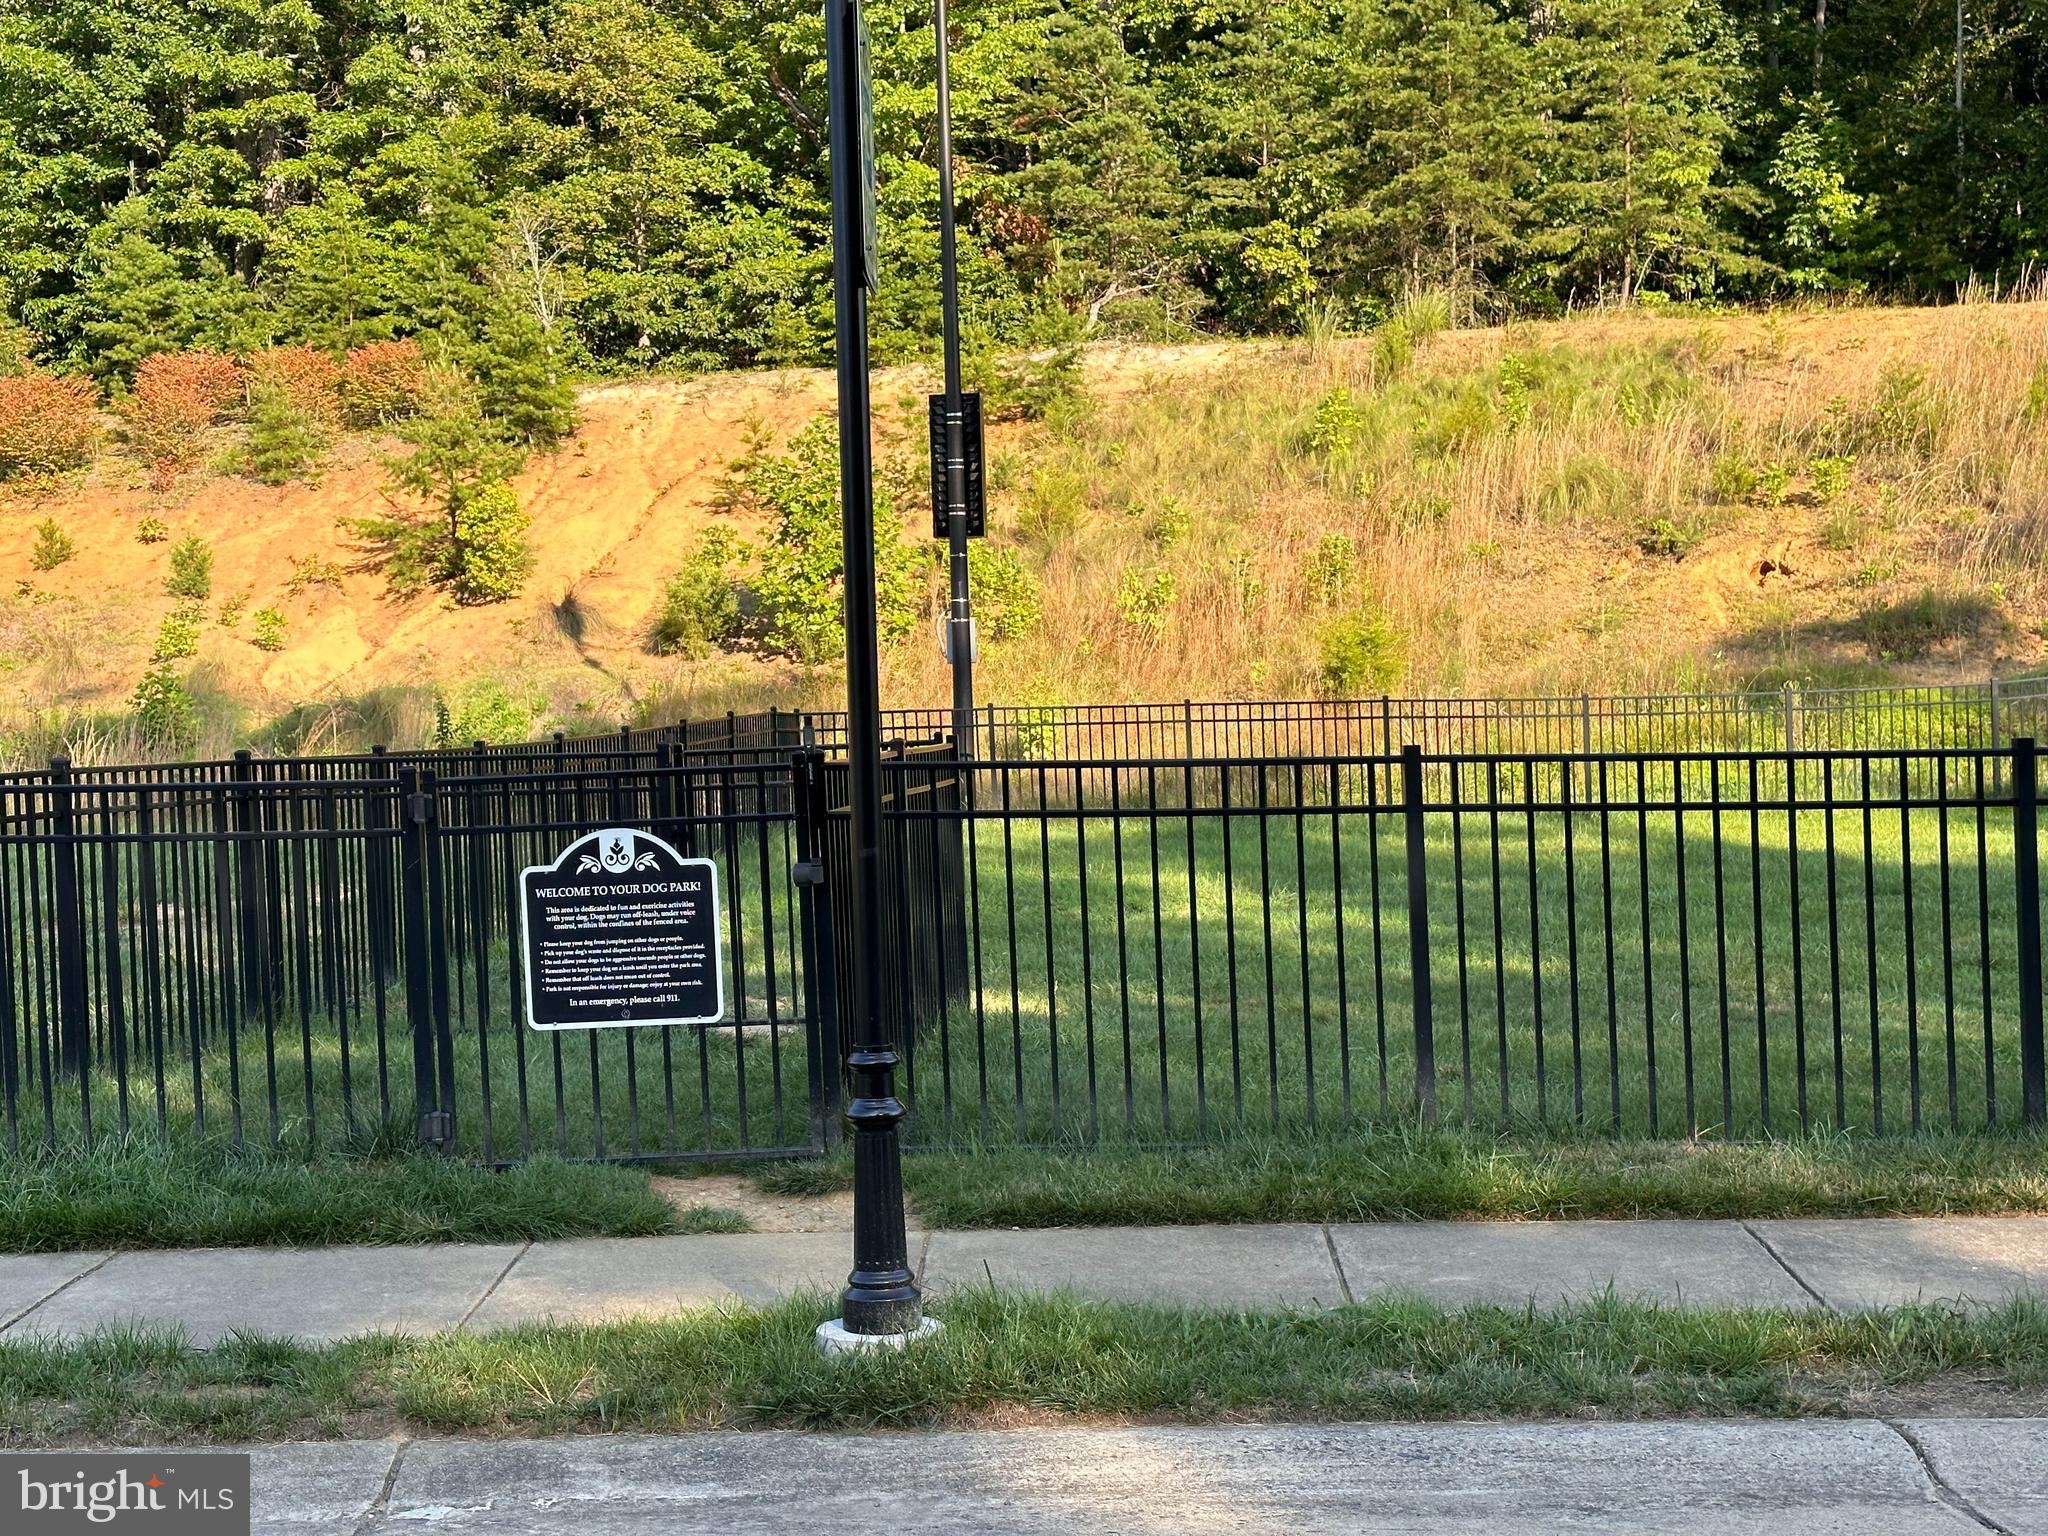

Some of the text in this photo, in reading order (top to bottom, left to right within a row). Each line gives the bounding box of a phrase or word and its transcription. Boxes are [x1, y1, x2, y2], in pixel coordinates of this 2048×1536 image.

[535, 881, 701, 898] WELCOME TO YOUR DOG PARK!
[590, 913, 606, 922] Dogs
[589, 998, 628, 1007] emergency,
[630, 996, 652, 1005] please
[653, 994, 665, 1002] call
